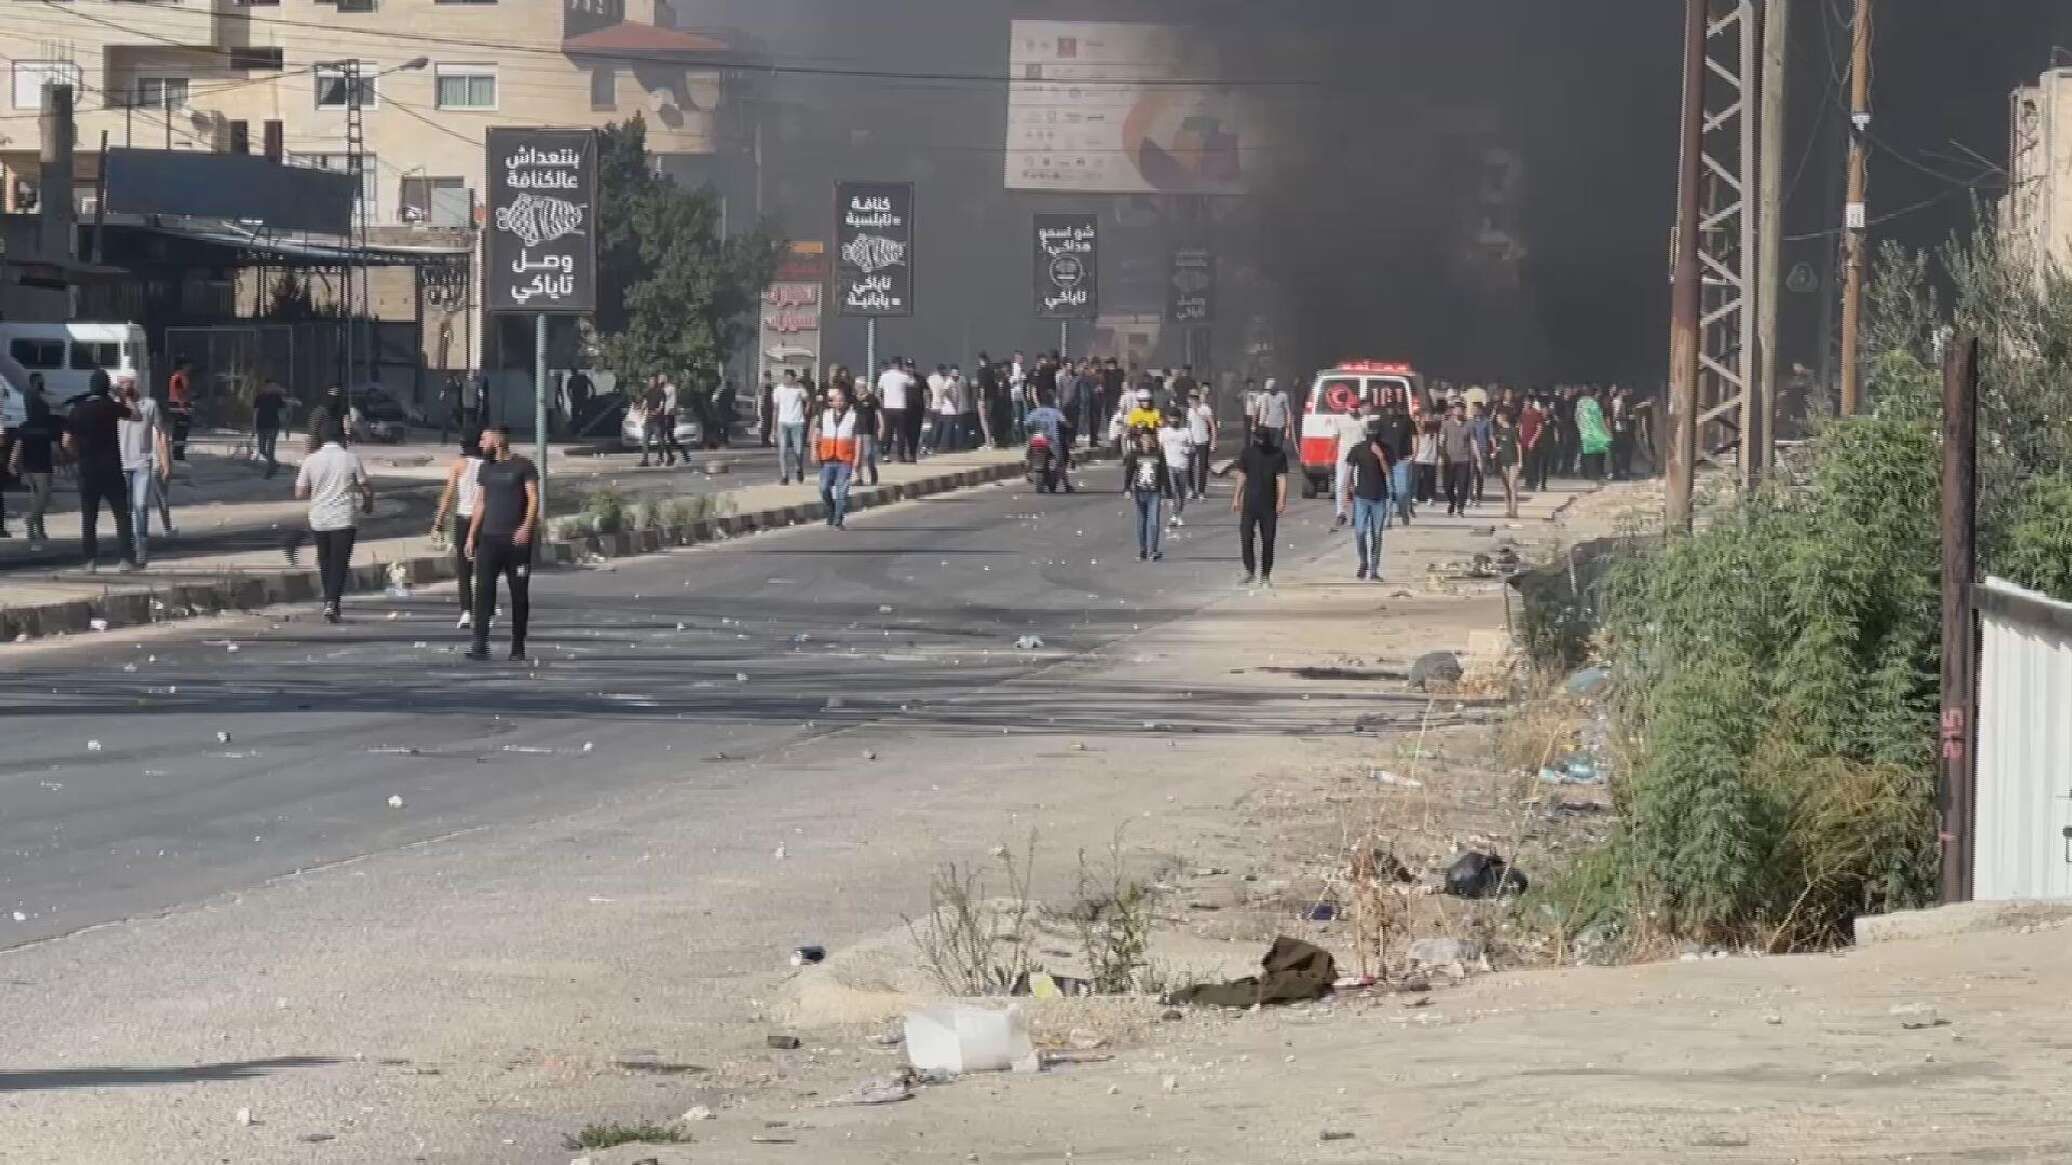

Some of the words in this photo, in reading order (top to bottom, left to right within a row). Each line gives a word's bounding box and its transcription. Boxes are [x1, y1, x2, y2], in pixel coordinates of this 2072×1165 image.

[507, 169, 579, 188] عالكنافة
[851, 195, 891, 210] كنافة
[512, 248, 574, 273] وصل
[511, 274, 575, 304] تاياكي
[852, 275, 891, 296] تاياكي
